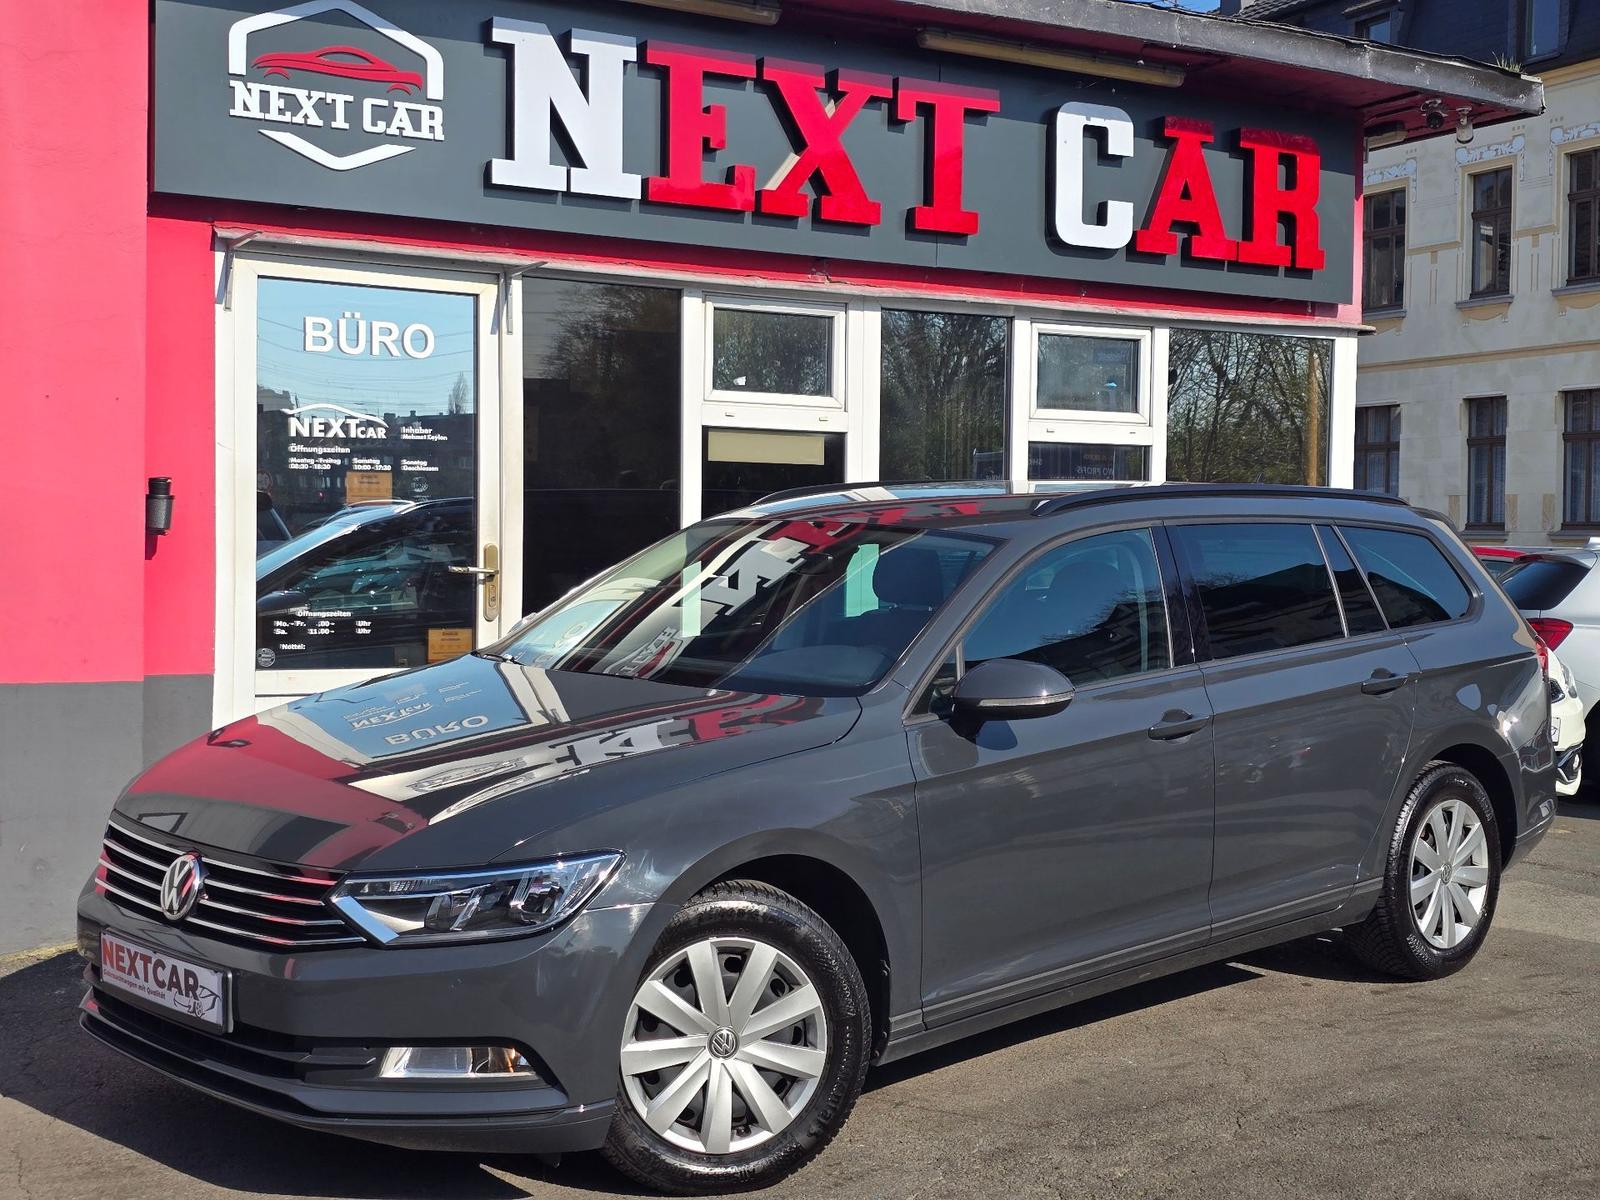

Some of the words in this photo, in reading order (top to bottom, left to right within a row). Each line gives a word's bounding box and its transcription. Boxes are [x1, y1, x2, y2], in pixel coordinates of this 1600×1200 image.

[229, 80, 354, 130] NEXT
[362, 97, 445, 141] CAR
[491, 16, 1000, 235] NEXT
[1055, 101, 1326, 271] CAR
[303, 311, 435, 359] BÜRO
[288, 443, 351, 454] Öffnungszeiten
[401, 426, 433, 434] Inhaber
[102, 938, 199, 1001] NEXTCAR
